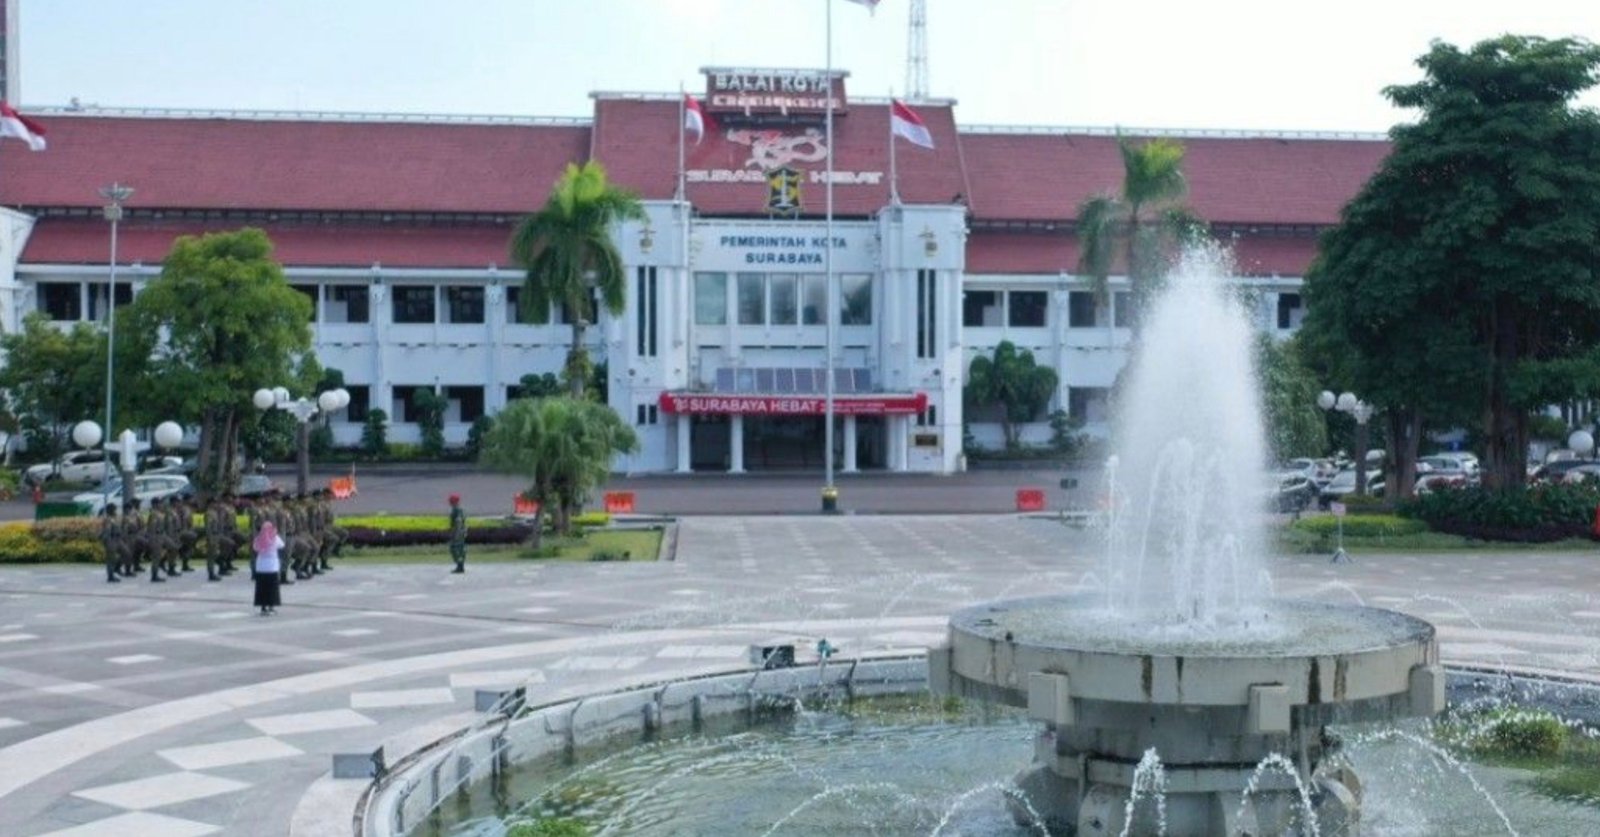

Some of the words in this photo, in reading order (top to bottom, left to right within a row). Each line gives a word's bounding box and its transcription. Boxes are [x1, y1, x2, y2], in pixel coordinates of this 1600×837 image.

[715, 74, 774, 92] BALAI
[781, 75, 831, 93] KOTA
[809, 170, 884, 185] HEBAT
[720, 236, 806, 248] PEMERINTAH
[745, 252, 823, 264] SURABAYA
[689, 399, 768, 413] SURABAYA
[770, 399, 818, 413] HEBAT
